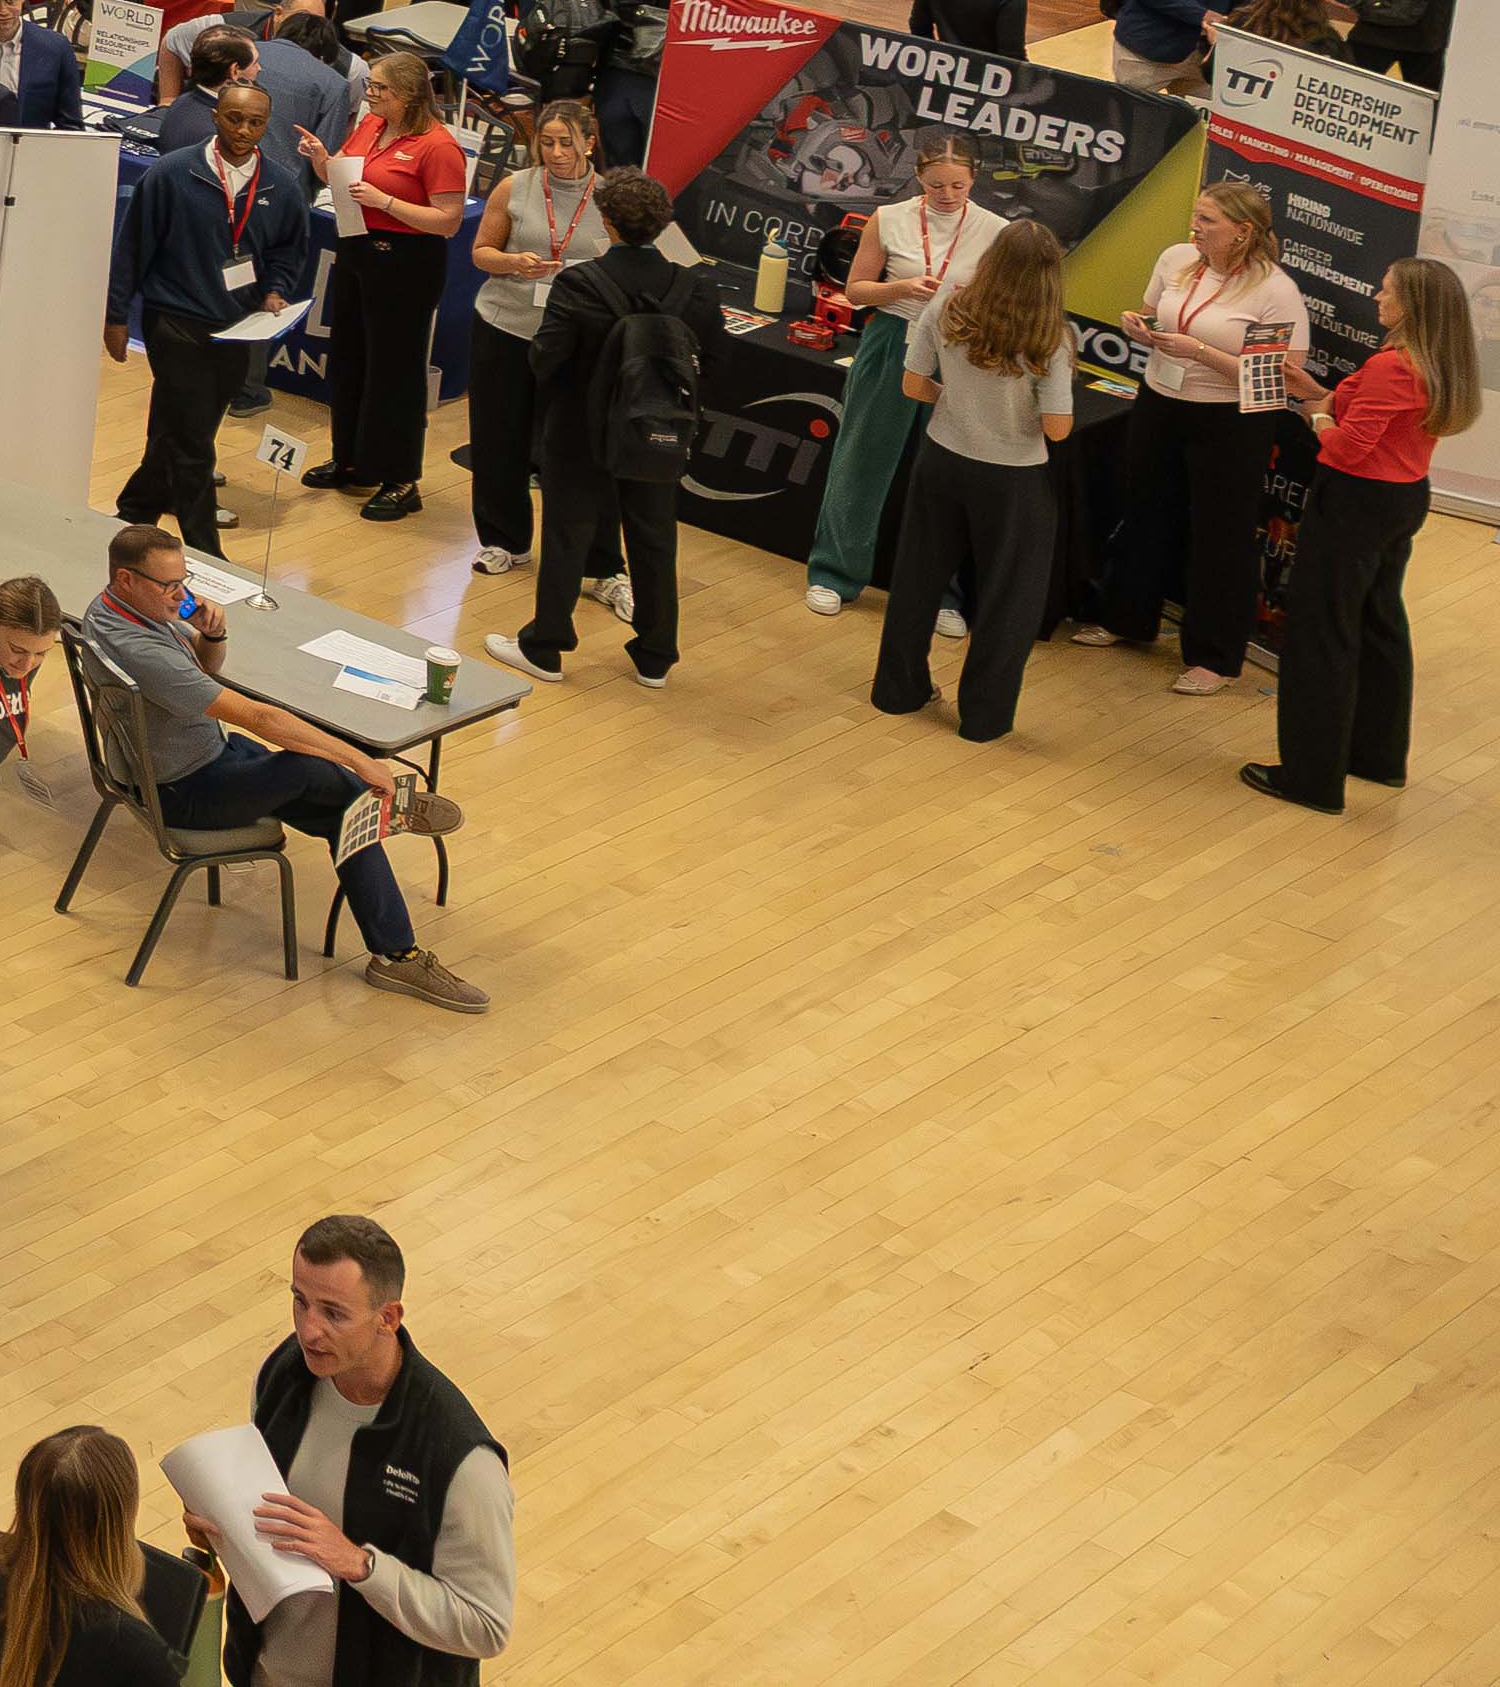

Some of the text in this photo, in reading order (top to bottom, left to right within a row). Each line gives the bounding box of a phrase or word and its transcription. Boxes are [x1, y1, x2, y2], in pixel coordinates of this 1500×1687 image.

[101, 2, 154, 26] WORLD
[860, 33, 1012, 98] WORLD
[1296, 74, 1402, 117] LEADERSHIP
[916, 87, 1125, 164] LEADERS
[1291, 110, 1373, 151] PROGRAM
[1293, 92, 1420, 146] DEVELOPMENT
[706, 199, 738, 227] IN
[1287, 192, 1331, 218] HIRING
[1285, 207, 1364, 246] NATIONWIDE
[1284, 238, 1332, 265] CAREER
[1281, 252, 1375, 297] ADVANCEMENT
[1324, 318, 1380, 349] CULTURE
[268, 438, 296, 472] 74
[386, 1464, 420, 1485] Deloitte
